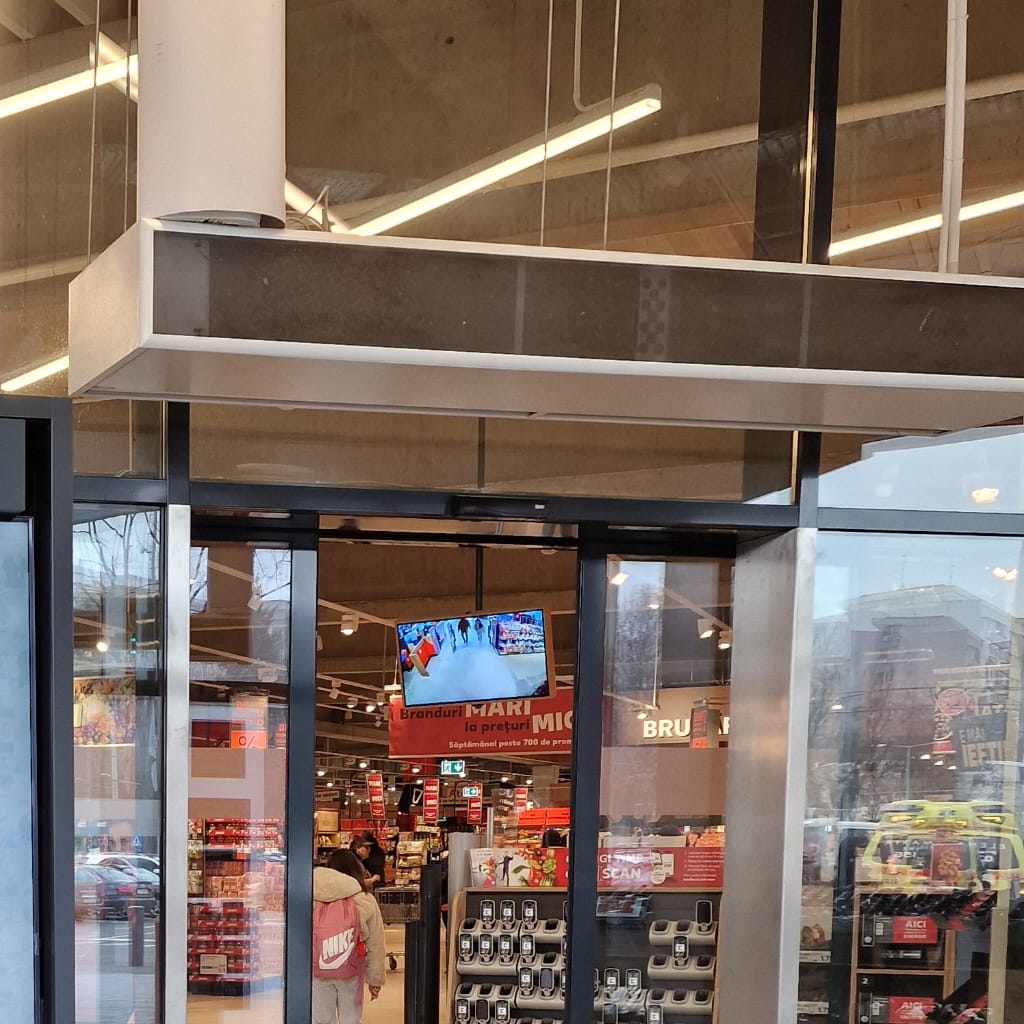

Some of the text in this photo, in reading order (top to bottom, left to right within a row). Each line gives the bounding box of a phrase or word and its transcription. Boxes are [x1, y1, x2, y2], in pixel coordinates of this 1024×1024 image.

[400, 700, 531, 720] Branduri MARI
[465, 711, 573, 734] la prețuri MIC
[449, 738, 573, 749] Săptămânal peste 700 de prom
[602, 868, 641, 879] SCAN
[905, 920, 927, 928] AICI
